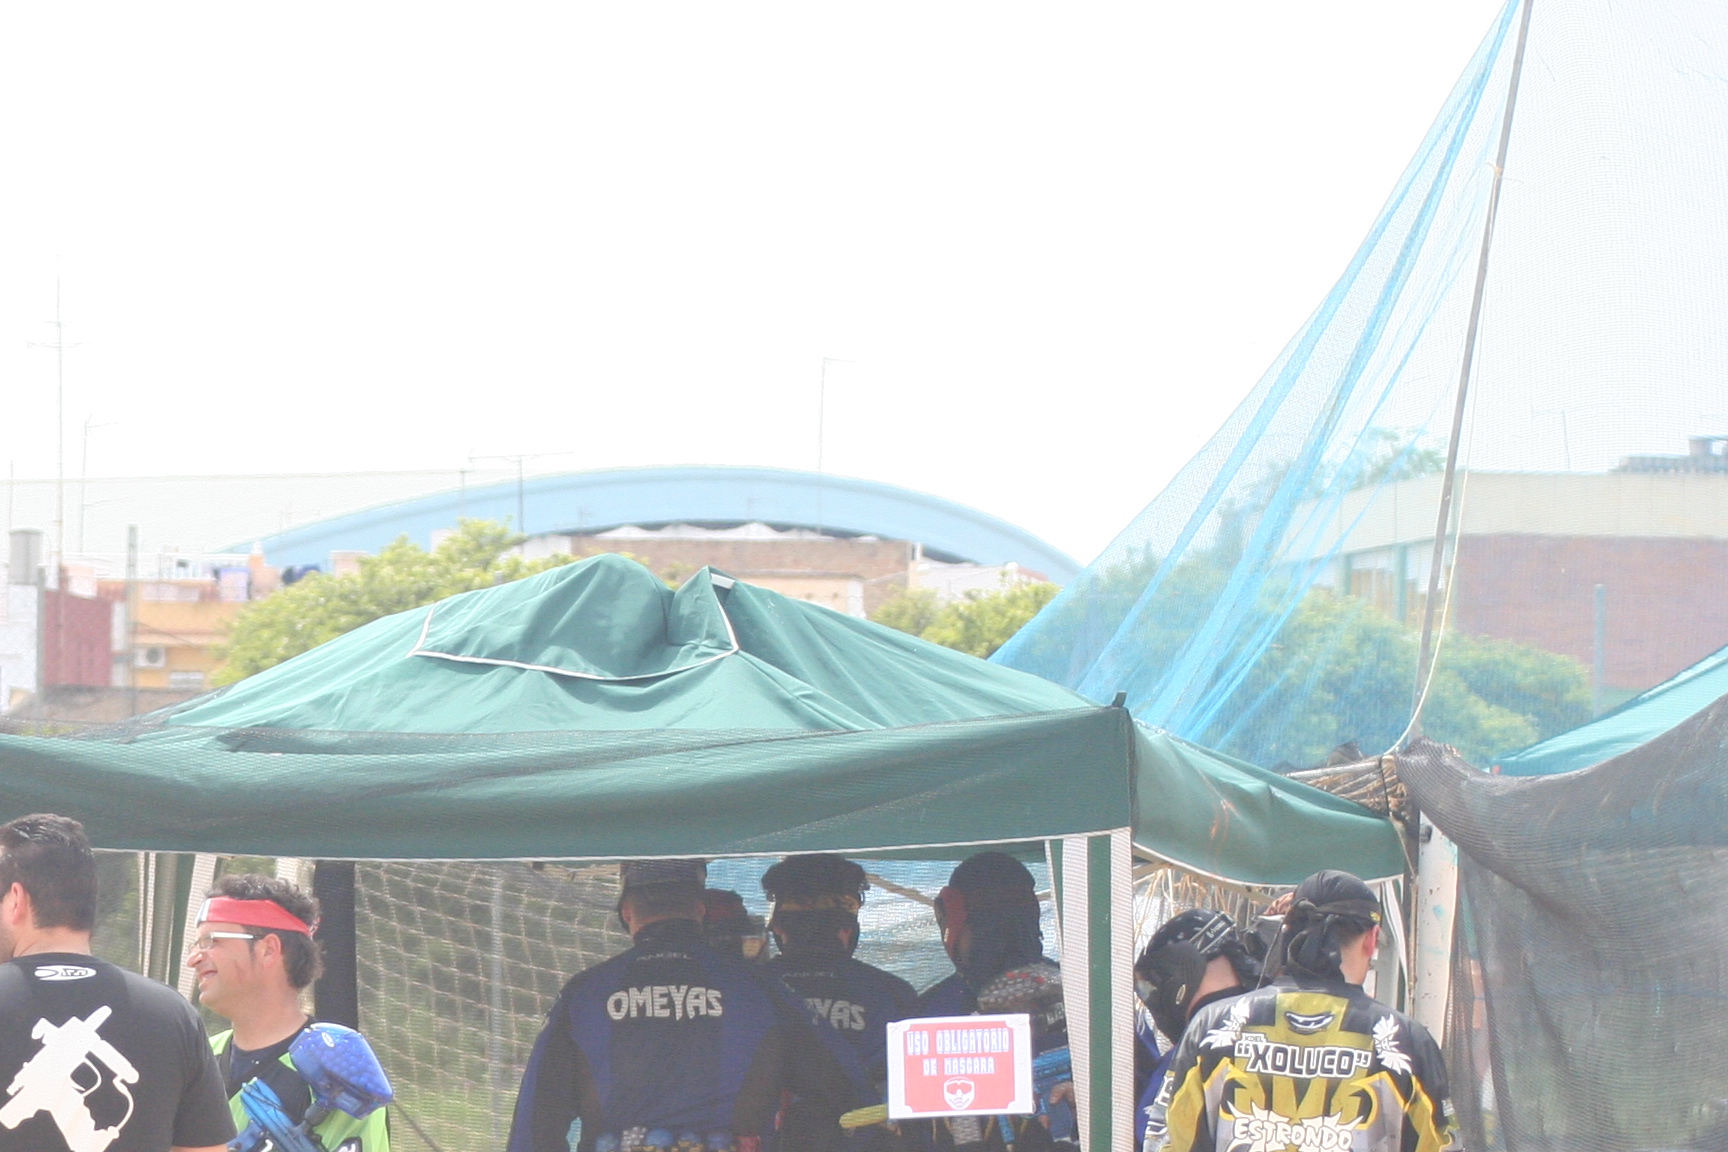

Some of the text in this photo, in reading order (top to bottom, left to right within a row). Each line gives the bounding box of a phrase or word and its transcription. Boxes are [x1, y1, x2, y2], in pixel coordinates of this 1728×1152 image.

[607, 985, 723, 1021] OMEYAS
[804, 997, 866, 1031] YAS
[906, 1028, 1010, 1056] USO OBLIGATORIO
[922, 1056, 995, 1076] DE MASCARA
[1234, 1118, 1354, 1150] ESTRONDO
